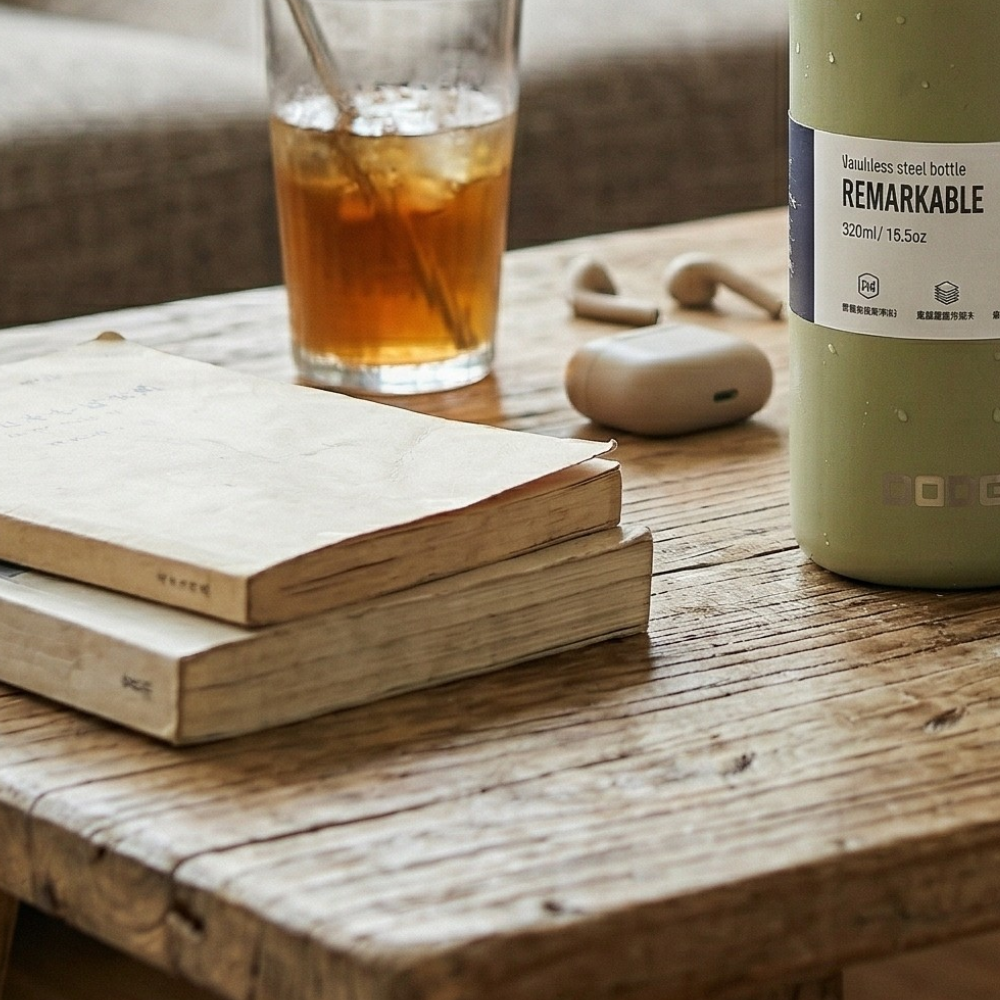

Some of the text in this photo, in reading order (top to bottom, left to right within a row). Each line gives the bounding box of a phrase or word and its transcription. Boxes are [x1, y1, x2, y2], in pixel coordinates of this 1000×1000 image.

[897, 161, 927, 176] steel
[930, 161, 966, 177] bottle
[842, 178, 985, 214] REMARKABLE
